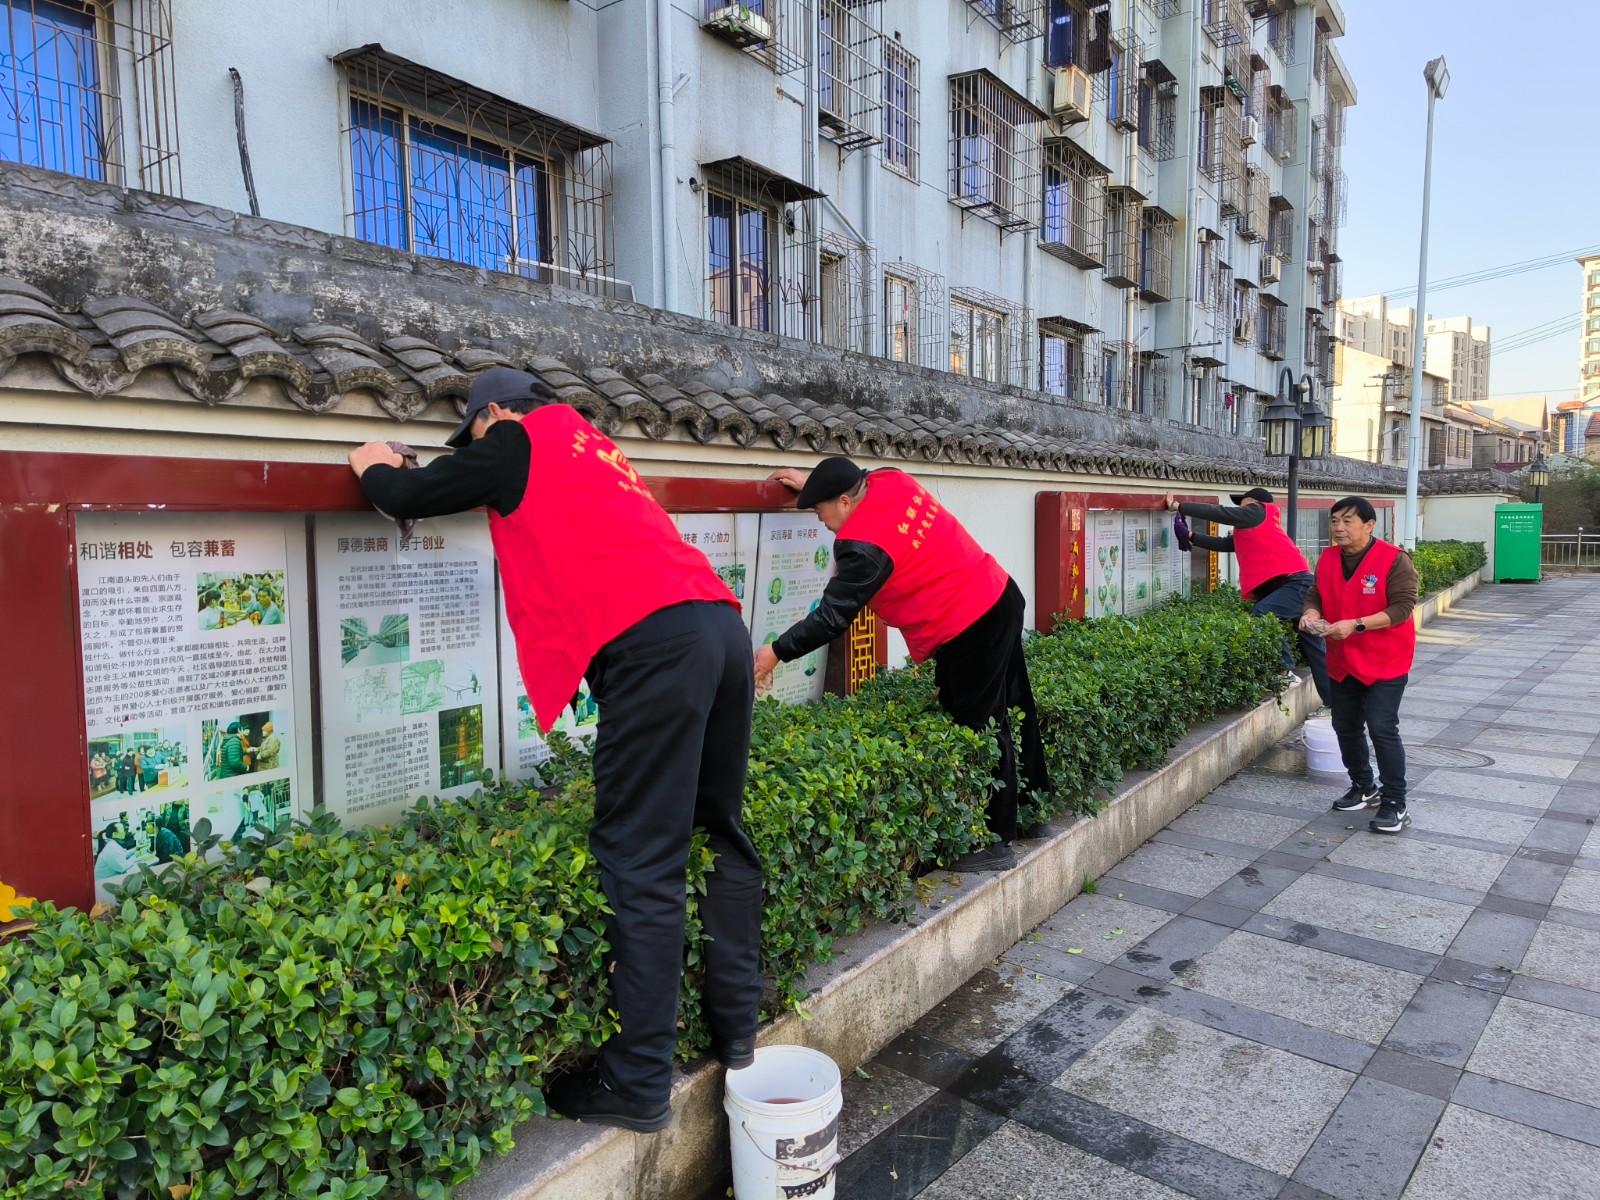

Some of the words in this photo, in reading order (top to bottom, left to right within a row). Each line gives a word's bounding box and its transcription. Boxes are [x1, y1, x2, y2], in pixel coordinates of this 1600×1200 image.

[337, 537, 388, 553] 厚德崇商
[399, 535, 445, 551] 勇于创业
[703, 531, 730, 544] 齐心协力
[80, 540, 153, 561] 和谐相处
[170, 539, 236, 558] 包容兼蓄
